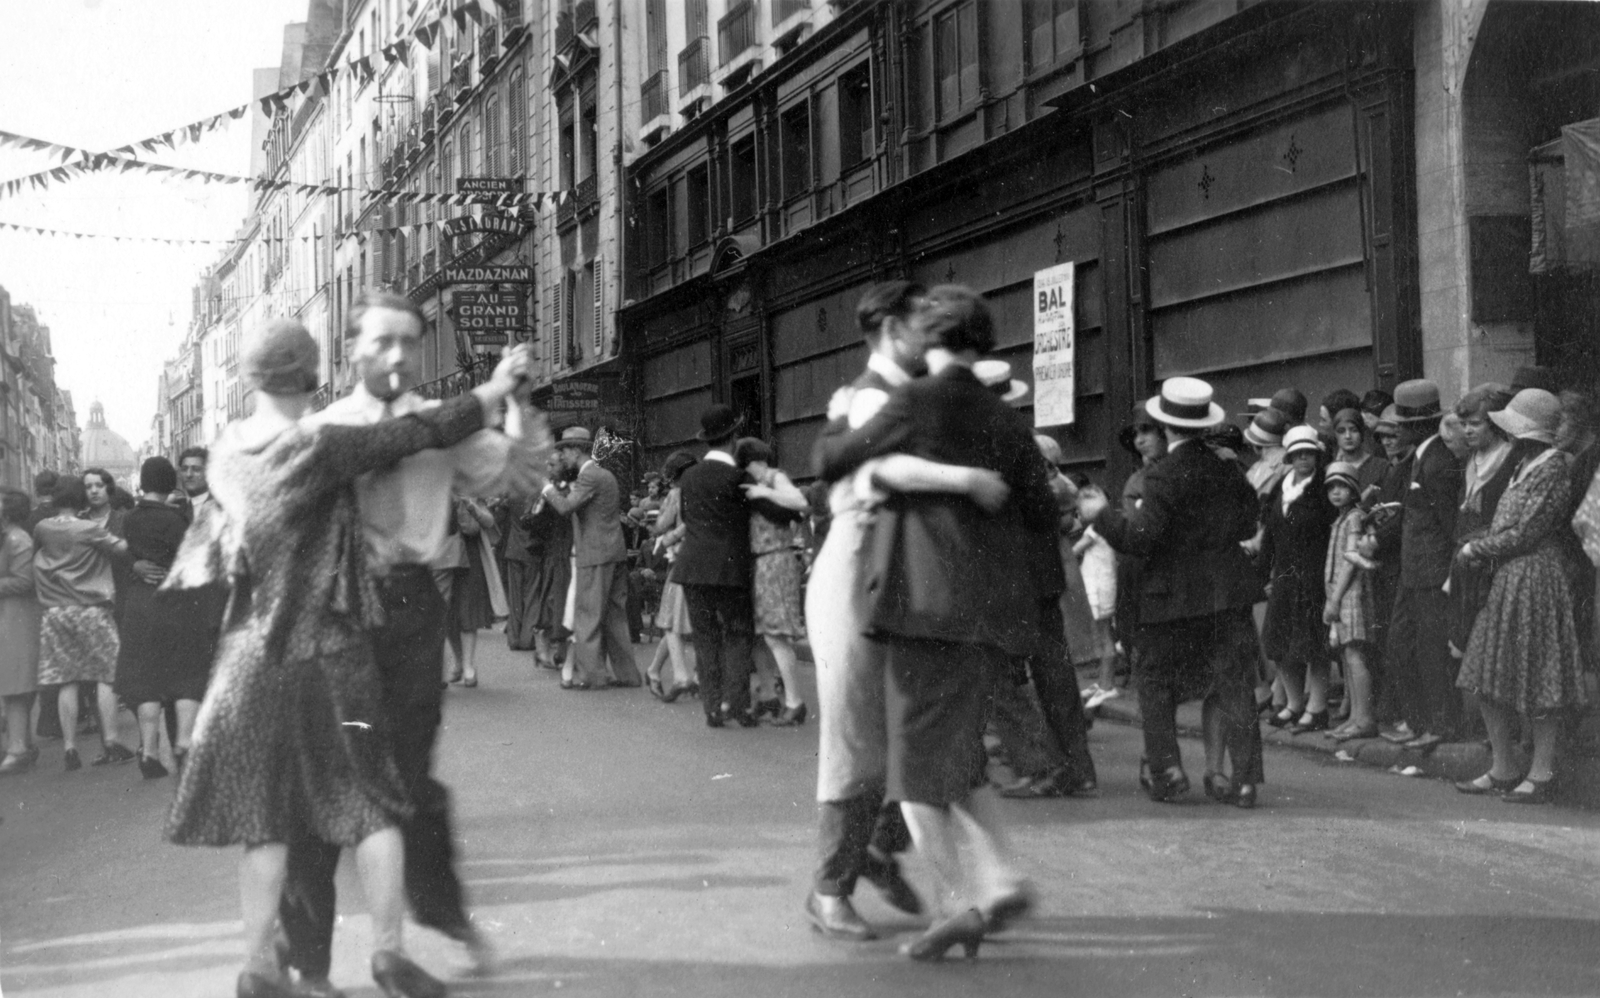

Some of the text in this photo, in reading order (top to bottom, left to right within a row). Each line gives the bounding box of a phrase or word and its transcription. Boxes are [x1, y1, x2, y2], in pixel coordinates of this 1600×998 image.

[463, 181, 506, 189] ANCIEN
[444, 216, 525, 236] RSTAURANT
[446, 268, 528, 280] MAZDAZNAN
[477, 294, 499, 303] AU
[1039, 286, 1066, 313] BAL
[459, 305, 519, 316] GRAND
[460, 317, 520, 327] SOLEIL
